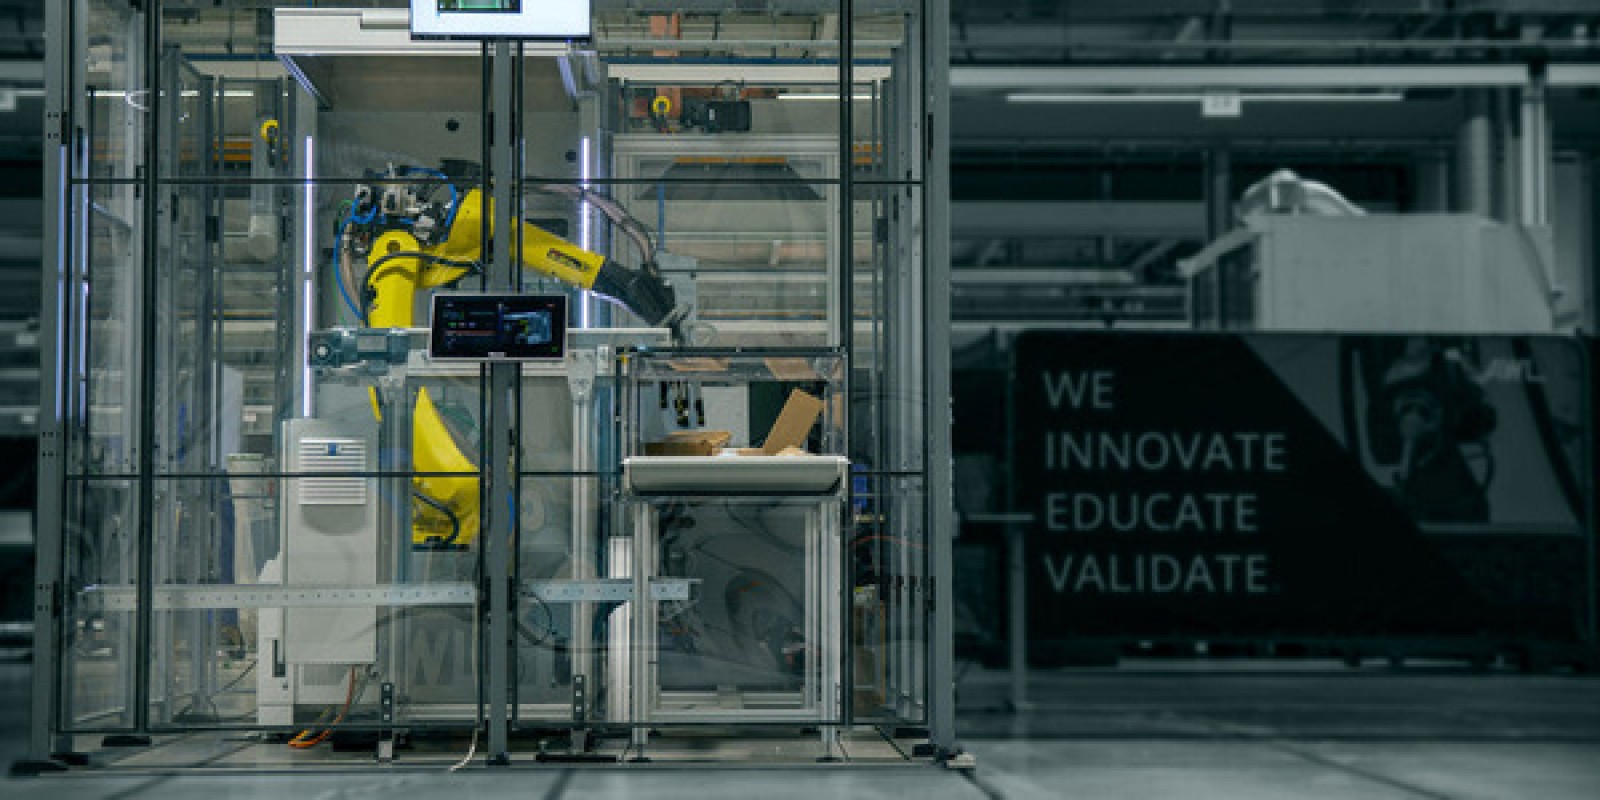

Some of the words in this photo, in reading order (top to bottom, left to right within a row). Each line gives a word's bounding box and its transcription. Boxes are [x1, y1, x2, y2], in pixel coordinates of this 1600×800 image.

[1043, 370, 1114, 409] WE
[1045, 431, 1286, 470] INNOVATE
[1046, 492, 1257, 532] EDUCATE
